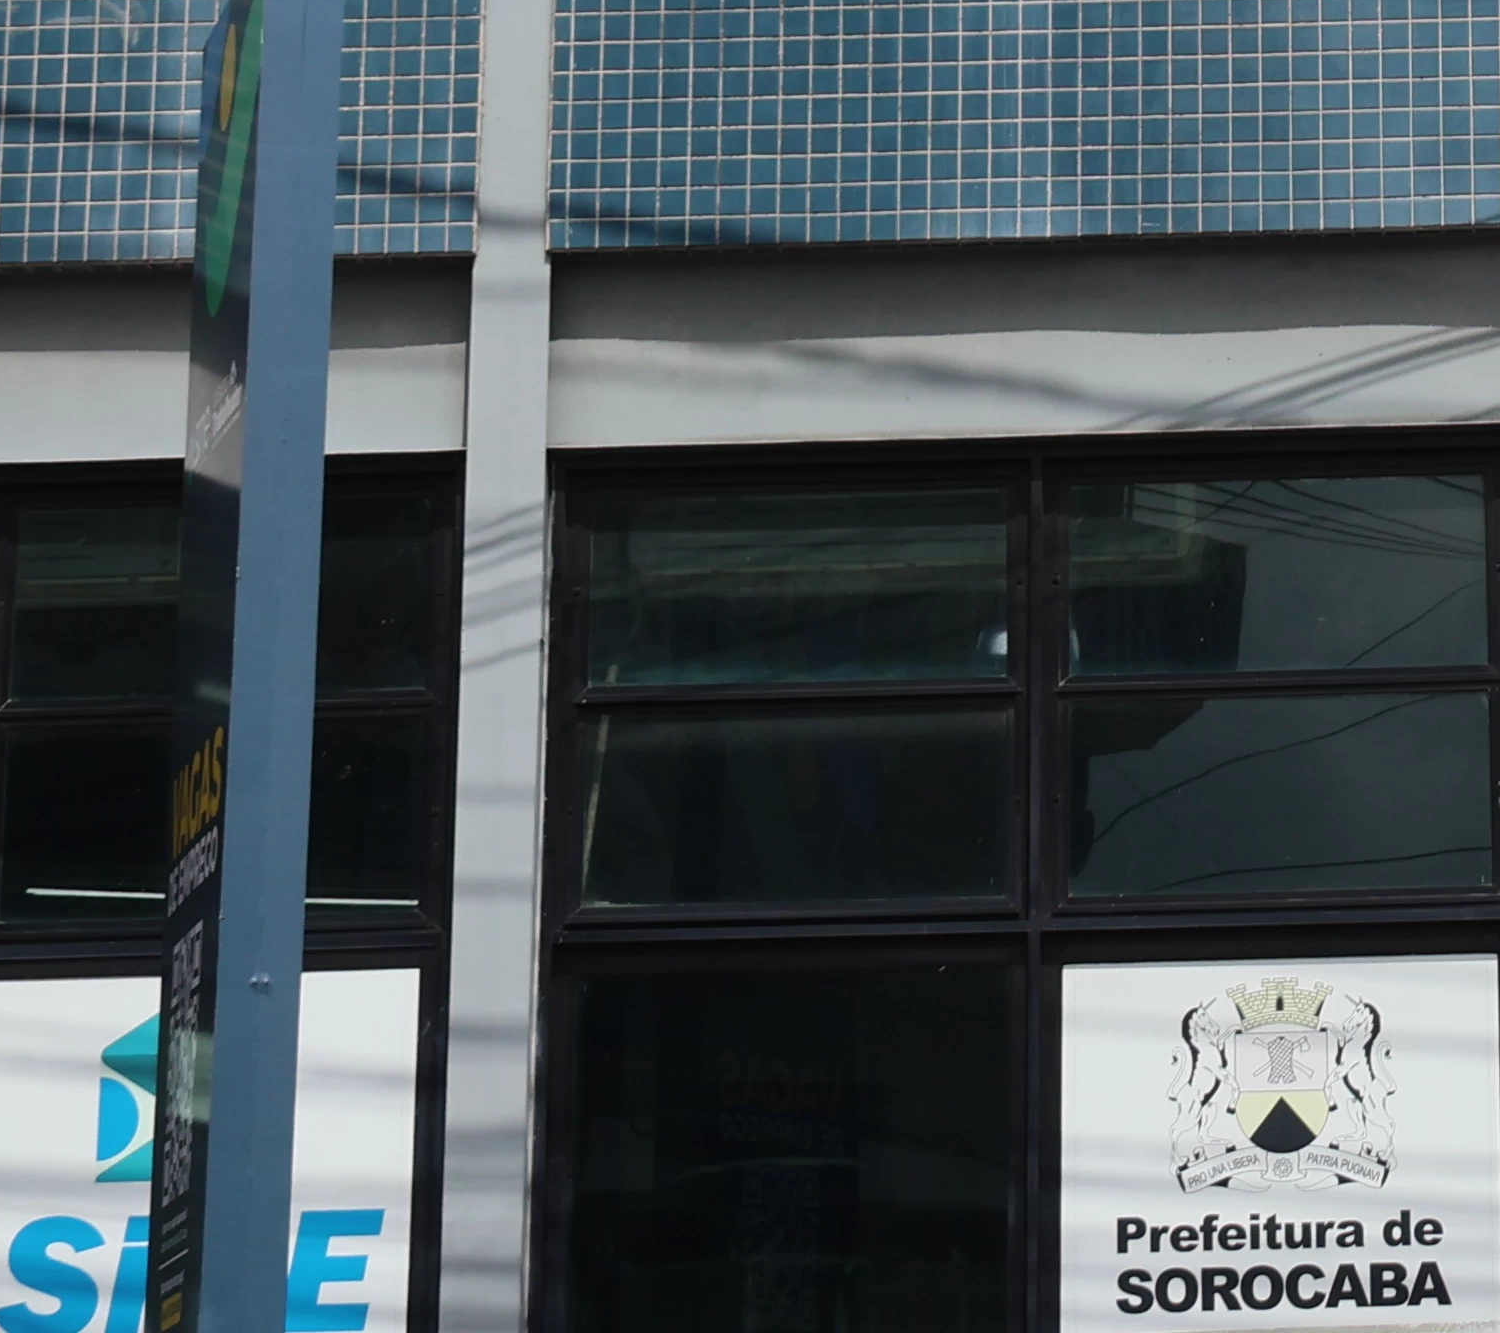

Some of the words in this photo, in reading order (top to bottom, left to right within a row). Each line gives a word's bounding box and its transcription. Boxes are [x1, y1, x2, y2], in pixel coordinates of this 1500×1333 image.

[1188, 1171, 1207, 1188] PRO
[1207, 1162, 1227, 1179] UNA
[1227, 1153, 1260, 1171] LIBERA
[1306, 1151, 1338, 1168] PATRIA
[1340, 1158, 1381, 1183] PUGNAVI
[1116, 1214, 1365, 1254] Prefeitura
[1382, 1210, 1444, 1247] de
[1115, 1261, 1453, 1315] SOROCABA
